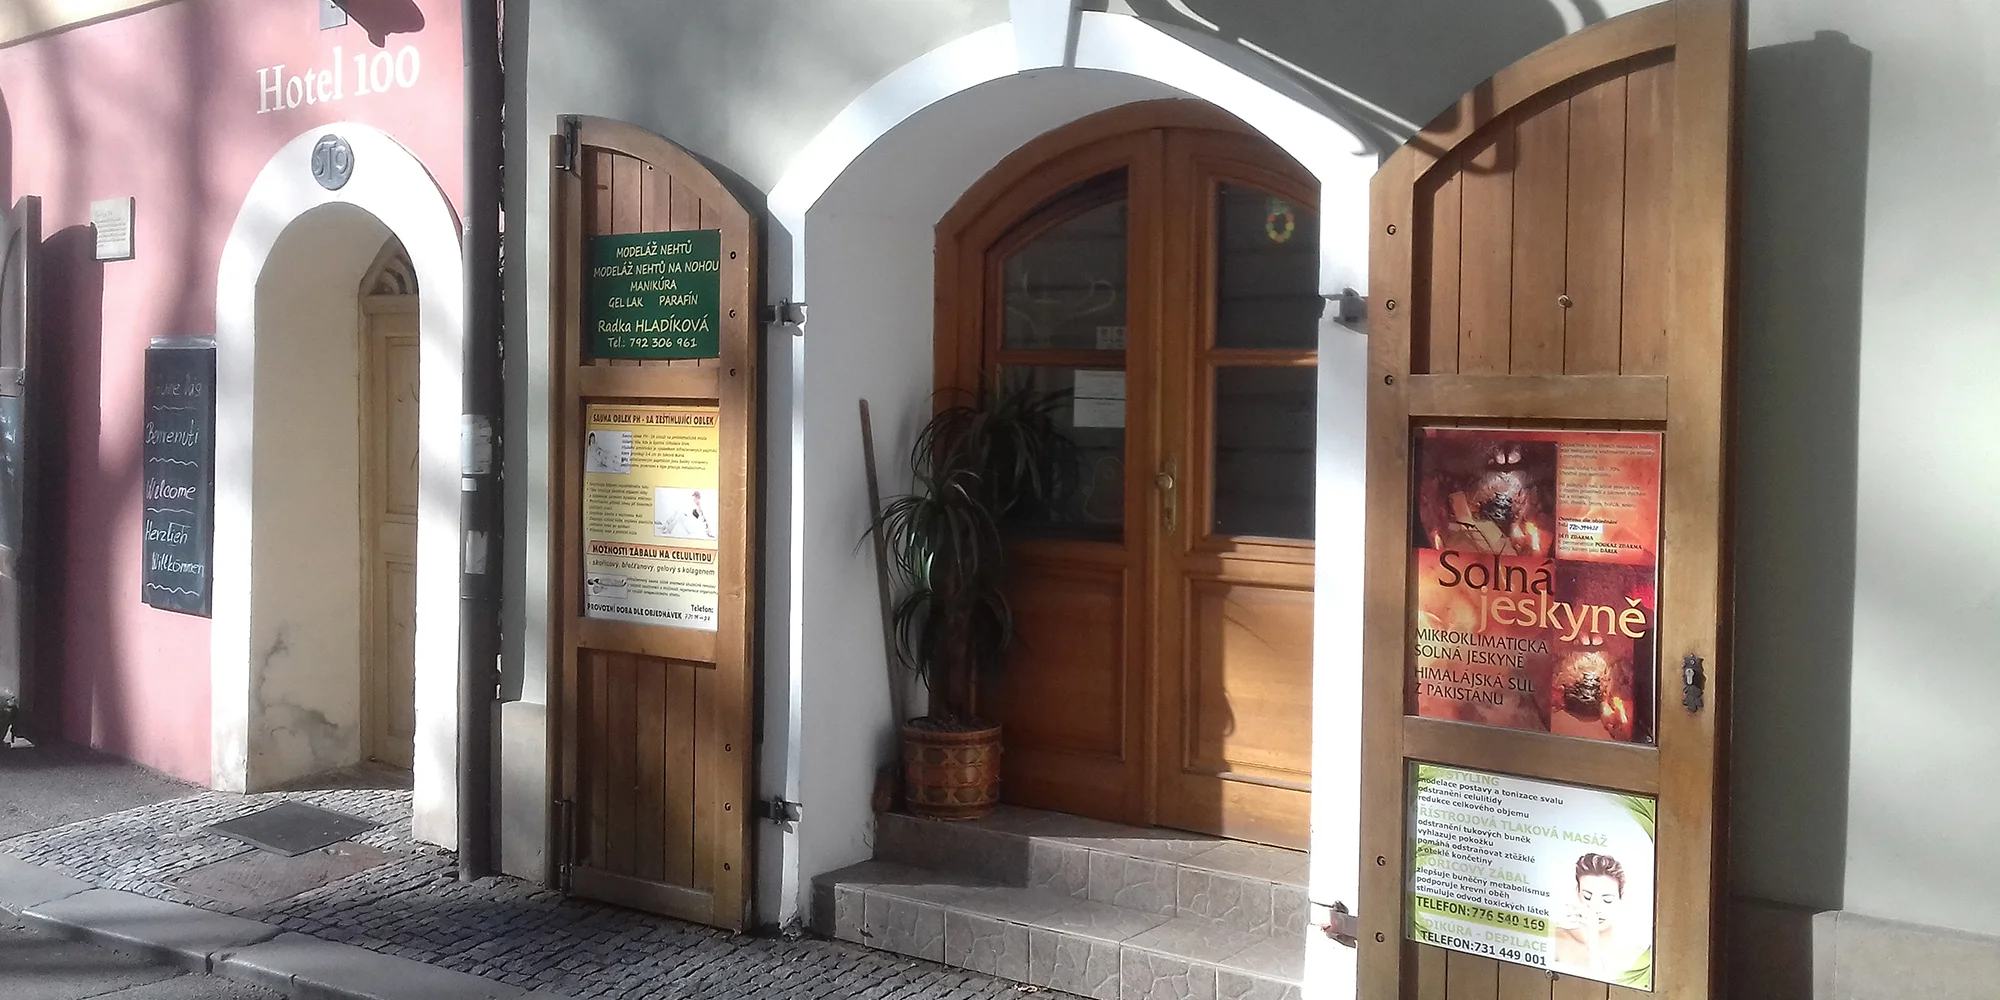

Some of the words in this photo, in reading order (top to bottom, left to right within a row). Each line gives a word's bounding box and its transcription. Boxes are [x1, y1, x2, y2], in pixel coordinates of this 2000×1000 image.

[256, 45, 343, 114] Hotel
[353, 45, 420, 96] 100
[616, 241, 658, 258] MODELÁŽ
[660, 239, 692, 255] NEHTŮ
[593, 261, 633, 277] MODELÁŽ
[635, 260, 666, 275] NEHTŮ
[668, 262, 682, 273] NA
[684, 260, 719, 272] NOHOU
[630, 276, 677, 291] MANIKÚRA
[608, 297, 625, 309] GEL
[626, 296, 644, 308] LAK
[659, 291, 699, 306] PARAFÍN
[598, 318, 632, 333] Radka
[635, 314, 709, 332] HLADÍKOVÁ
[629, 337, 649, 348] 792
[651, 337, 673, 348] 306
[676, 337, 698, 348] 961
[613, 413, 632, 424] OBLEK
[694, 416, 714, 426] OBLEK
[146, 477, 196, 500] Welcome
[592, 544, 628, 556] MOŽNOSTI
[659, 550, 670, 559] NA
[672, 550, 712, 562] CELULITIDU
[682, 566, 715, 576] kolagenem
[1438, 550, 1555, 596] Solná
[633, 606, 643, 616] DLE
[644, 607, 682, 620] OBJEDNÁVEK
[1476, 585, 1646, 642] jeskyně
[1414, 644, 1462, 661] SOLNÁ
[1466, 650, 1525, 669] JESKYNĚ
[1414, 666, 1504, 689] HIMALÁJSKÁ
[1418, 785, 1462, 798] odstranění
[1463, 793, 1503, 805] celulitidy
[1459, 783, 1492, 795] postavy
[1501, 789, 1538, 801] tonizace
[1418, 794, 1450, 805] redukce
[1452, 800, 1494, 812] celkového
[1496, 806, 1530, 818] objemu
[1417, 819, 1461, 832] odstranění
[1463, 825, 1502, 838] tukových
[1504, 832, 1531, 843] buněk
[1417, 828, 1456, 841] vyhlazuje
[1458, 834, 1494, 847] pokožku
[1501, 820, 1559, 839] TLAKOVÁ
[1562, 830, 1608, 847] MASÁŽ
[1417, 837, 1450, 848] pomáhá
[1452, 842, 1502, 858] odstraňovat
[1424, 847, 1450, 857] oteklé
[1451, 851, 1493, 866] končetiny
[1416, 865, 1450, 879] zlepšuje
[1452, 872, 1488, 887] buněčný
[1489, 880, 1550, 897] metabolismus
[1489, 865, 1530, 884] ZÁBAL
[1416, 875, 1458, 890] podporuje
[1460, 884, 1487, 896] krevní
[1488, 889, 1510, 900] oběh
[1416, 885, 1455, 898] stimuluje
[1456, 892, 1482, 903] odvod
[1484, 897, 1525, 912] toxických
[1527, 905, 1550, 916] látek
[1497, 912, 1520, 926] 540
[1523, 917, 1545, 931] 169
[1485, 930, 1547, 953] DEPILACE
[1499, 947, 1521, 961] 449
[1524, 952, 1547, 967] 001
